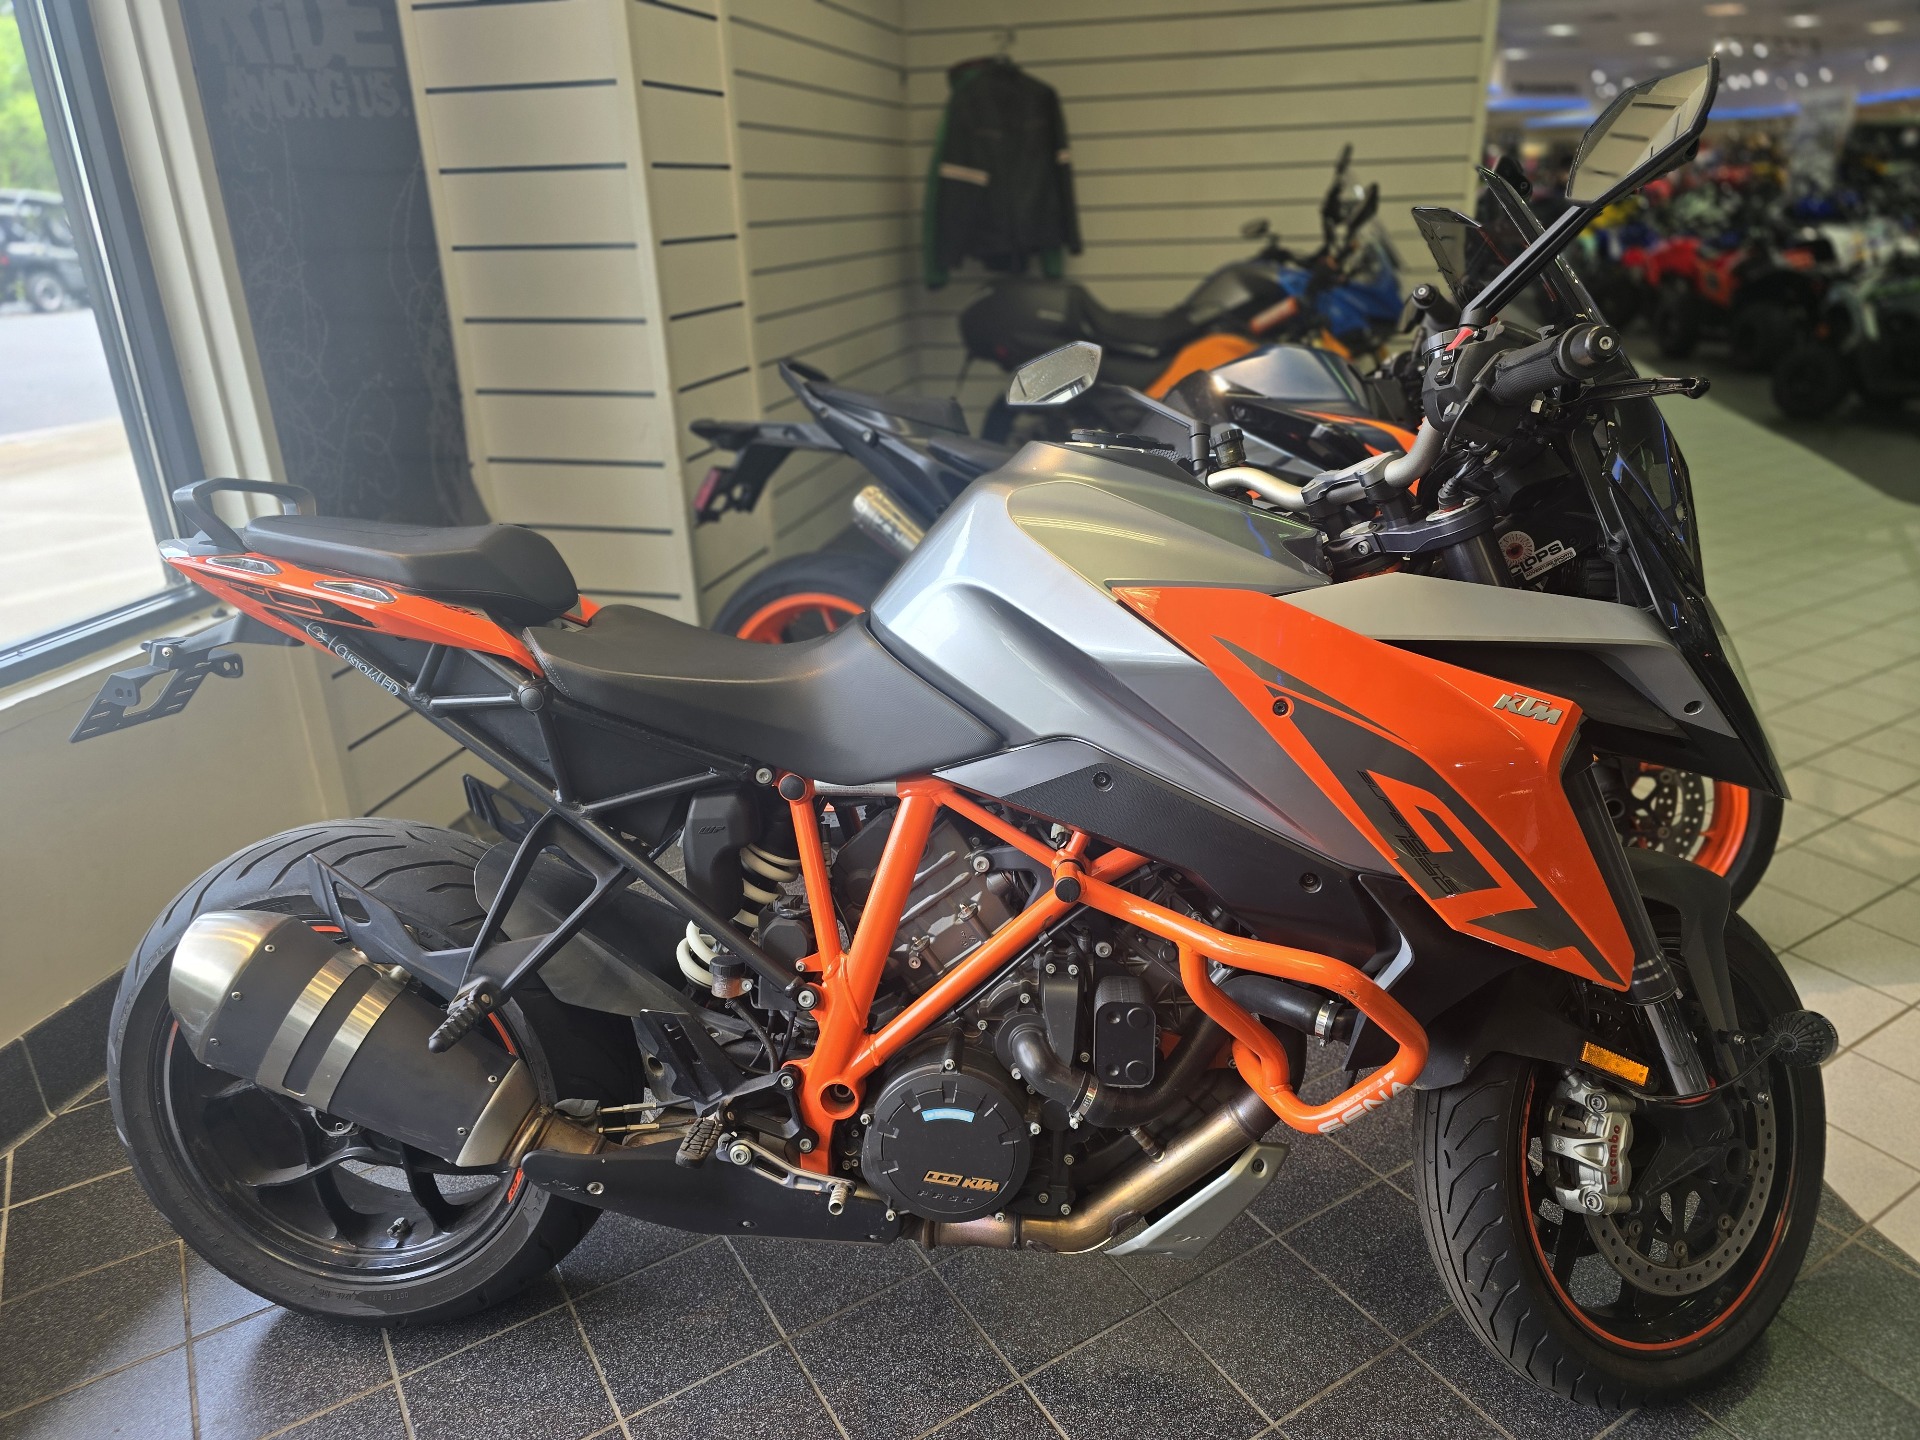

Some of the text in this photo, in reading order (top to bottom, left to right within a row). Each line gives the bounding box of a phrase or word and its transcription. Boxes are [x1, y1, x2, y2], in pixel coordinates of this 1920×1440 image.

[222, 66, 349, 118] AMONG
[1493, 691, 1563, 725] KTM
[1394, 834, 1454, 895] 1290
[1608, 1124, 1621, 1186] brembo
[961, 1177, 1000, 1192] KTM
